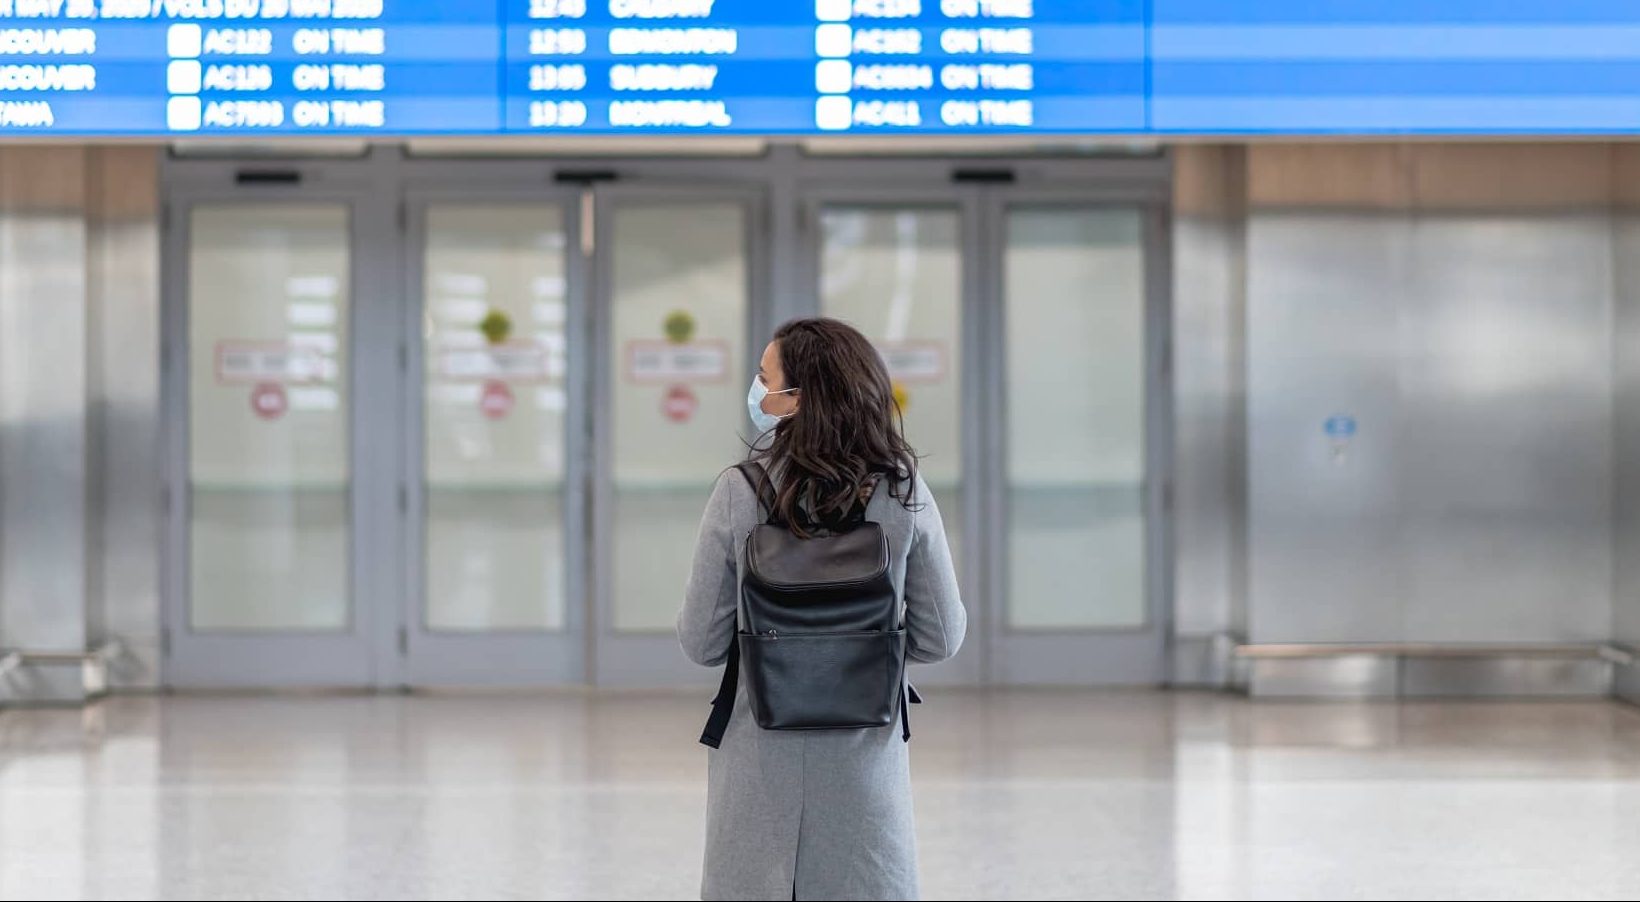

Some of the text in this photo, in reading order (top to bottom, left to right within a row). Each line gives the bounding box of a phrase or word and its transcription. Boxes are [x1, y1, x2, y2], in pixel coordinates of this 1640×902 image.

[15, 0, 63, 17] MAY
[225, 0, 260, 17] DU
[293, 29, 330, 54] ON
[331, 29, 384, 54] TIME
[609, 29, 737, 54] EDMONTON
[941, 29, 979, 54] ON
[980, 29, 1032, 54] TIME
[293, 65, 330, 90] ON
[331, 65, 384, 90] TIME
[941, 65, 979, 90] ON
[980, 65, 1032, 90] TIME
[293, 101, 330, 126] ON
[331, 101, 384, 126] TIME
[609, 101, 732, 126] MONTREAL
[941, 101, 979, 126] ON
[980, 101, 1032, 126] TIME
